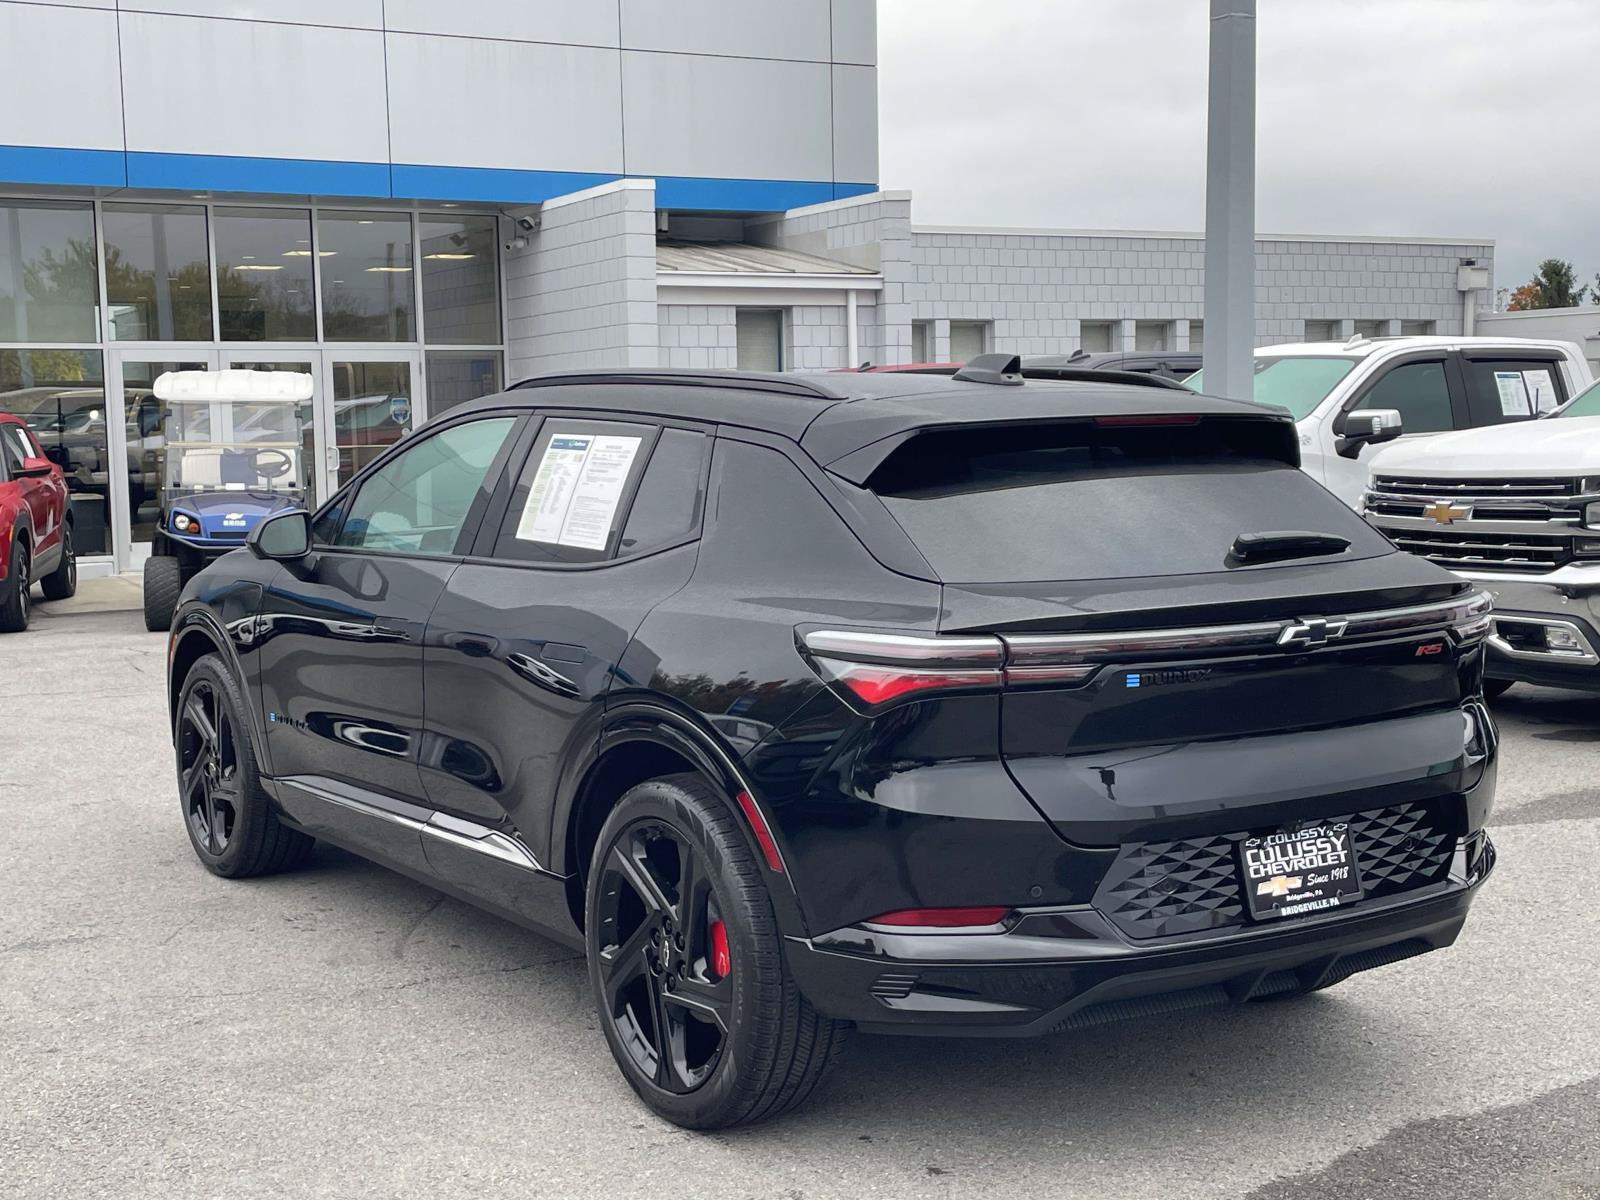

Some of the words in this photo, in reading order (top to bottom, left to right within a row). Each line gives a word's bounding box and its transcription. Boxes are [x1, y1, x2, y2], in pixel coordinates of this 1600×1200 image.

[1415, 643, 1443, 656] RS
[1267, 826, 1327, 845] COLUSSY
[1246, 834, 1346, 866] COLUSSY
[1249, 850, 1348, 878] CHEVROLET
[1306, 873, 1330, 886] Since
[1330, 866, 1349, 880] 1918
[1329, 897, 1340, 906] PA
